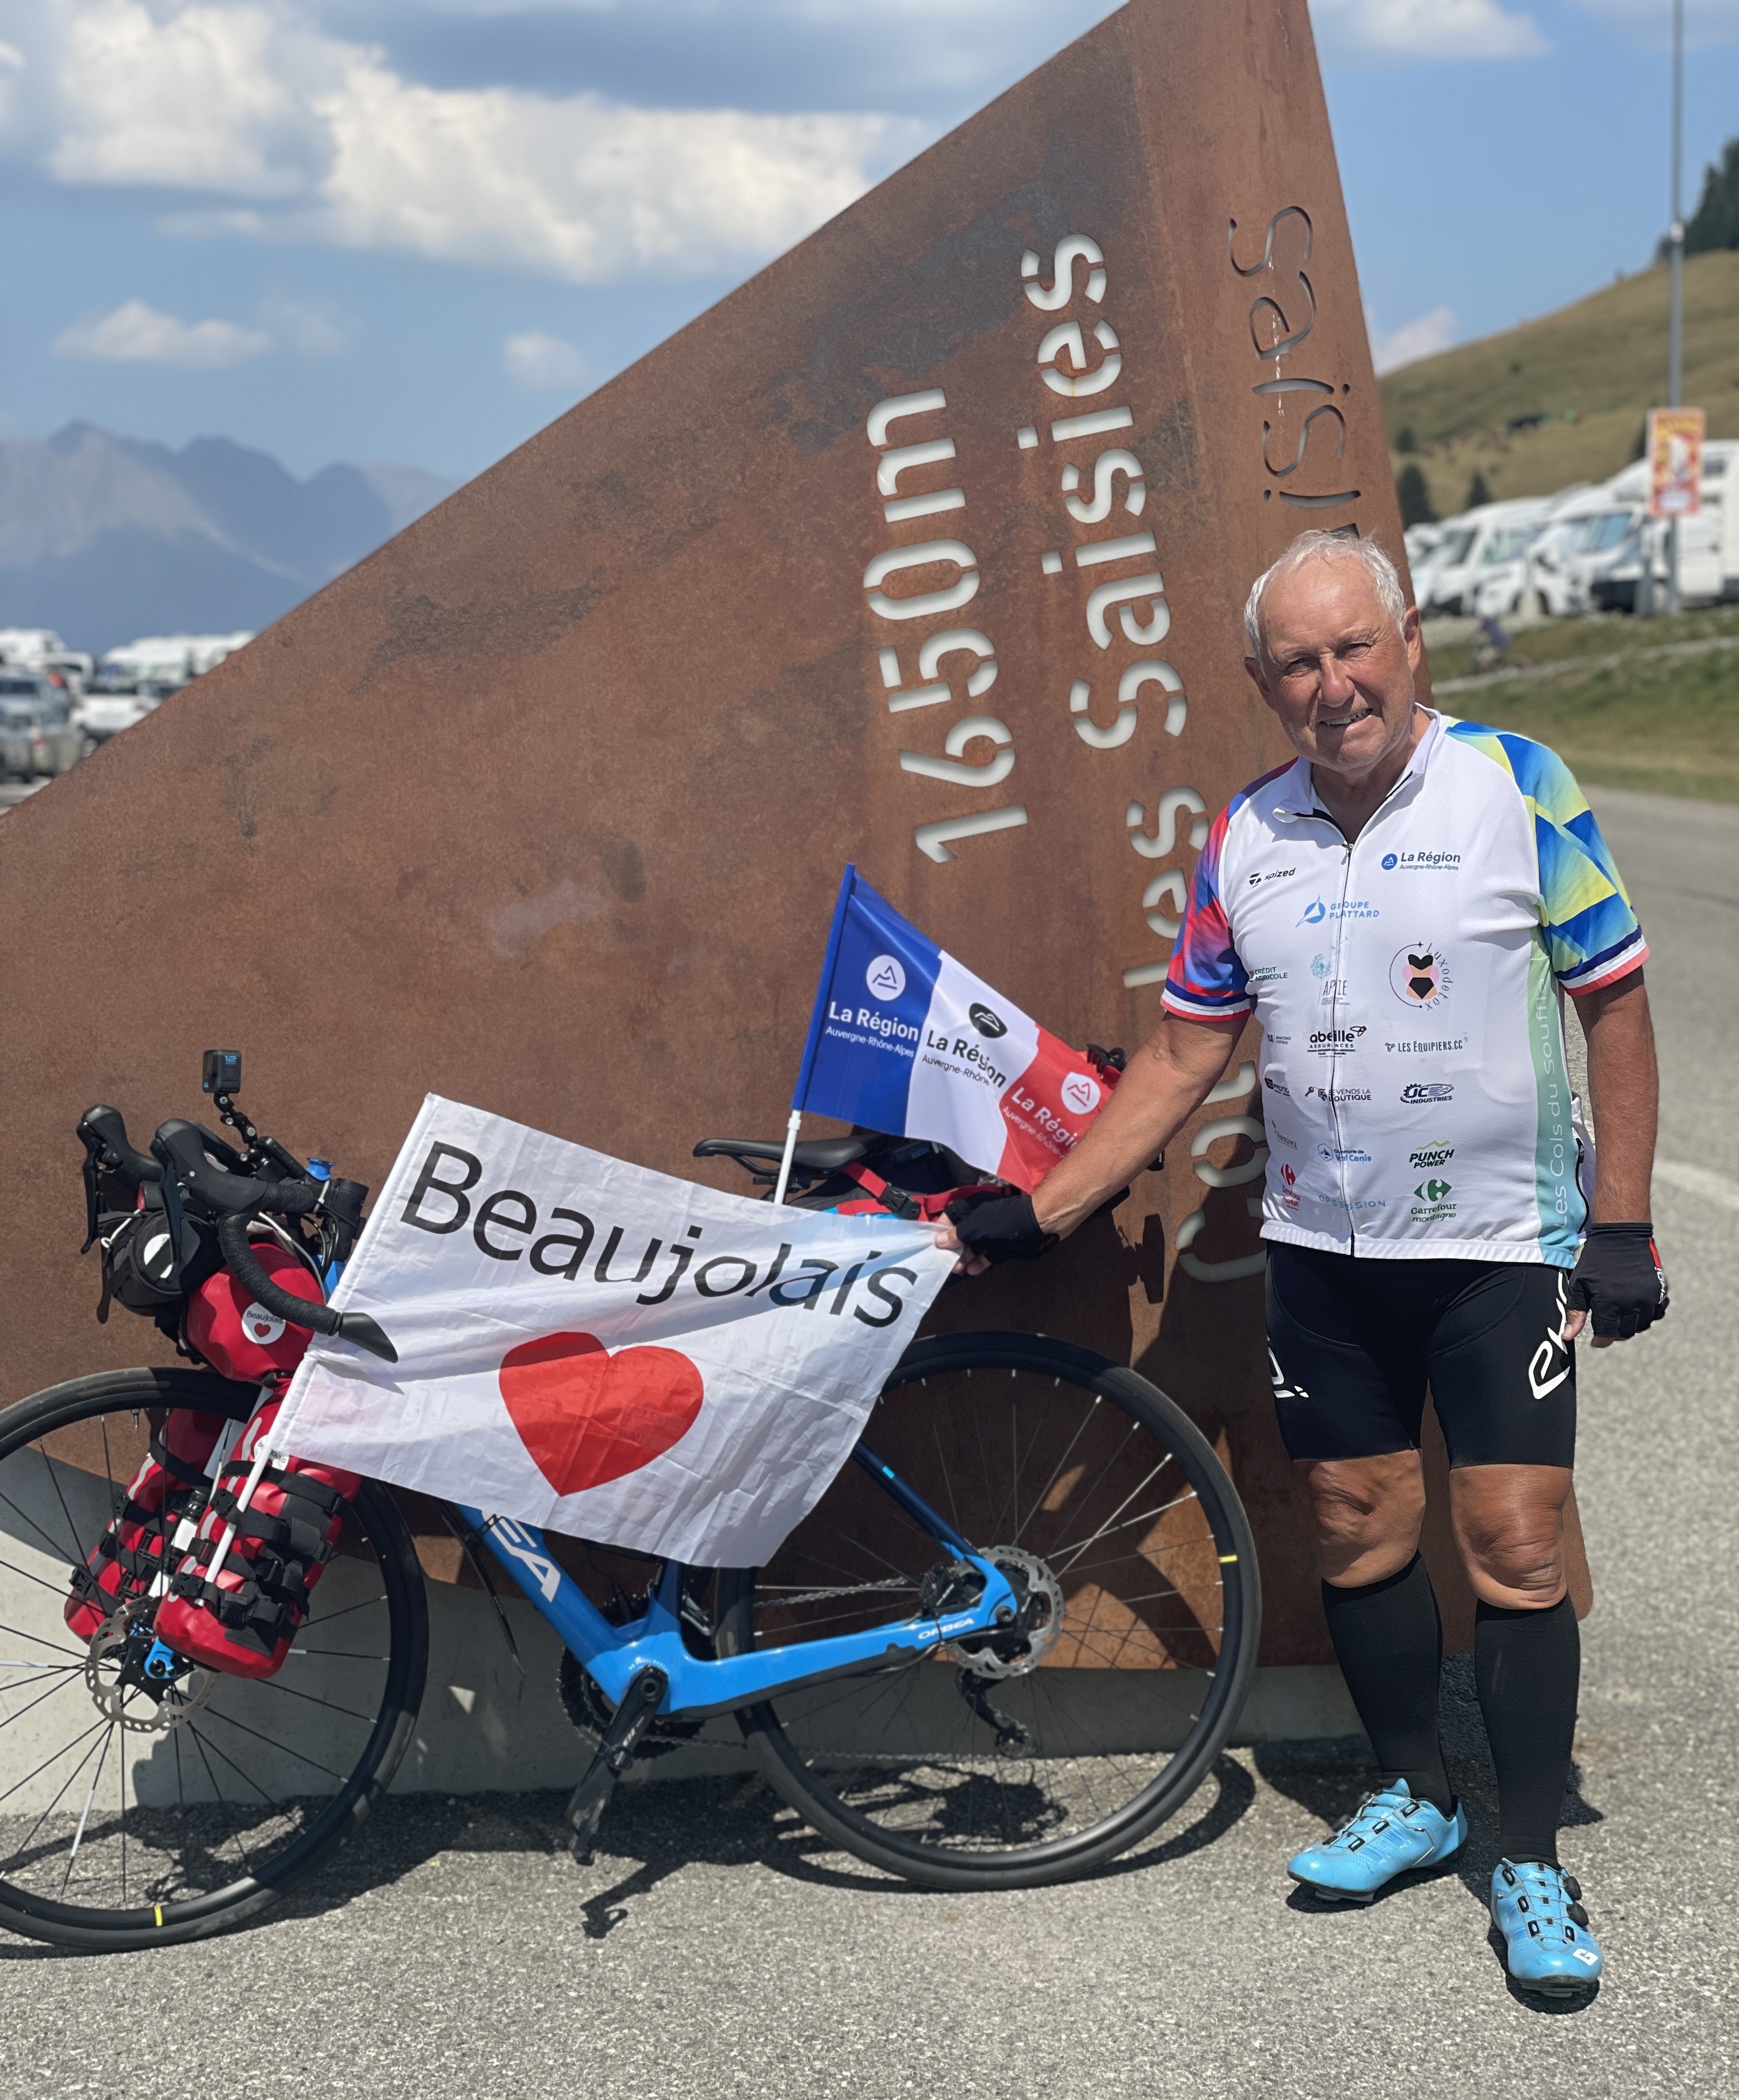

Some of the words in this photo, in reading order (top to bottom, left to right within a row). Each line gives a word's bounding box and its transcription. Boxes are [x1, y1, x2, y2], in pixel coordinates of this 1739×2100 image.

[1017, 233, 1188, 748] Saisies
[864, 388, 1028, 863] 1650m
[1401, 852, 1415, 862] La
[1418, 851, 1461, 864] Région
[1329, 910, 1380, 919] PLATTARD
[1254, 967, 1277, 975] CRÉDIT
[1254, 972, 1289, 982] AGRICOLE
[1426, 942, 1454, 1011] Luxodetox
[829, 1001, 853, 1022] La
[856, 1007, 919, 1042] Région
[826, 1026, 914, 1057] Auvergne-Rhône-Alpes
[926, 1029, 948, 1051] La
[1309, 1029, 1355, 1043] abeille
[1398, 1042, 1411, 1052] LES
[224, 1055, 237, 1063] 12
[922, 1055, 990, 1086] Auvergne-Rhône
[1410, 1095, 1453, 1105] INDUSTRIES
[1548, 1083, 1560, 1117] du
[1011, 1086, 1035, 1112] La
[1033, 1106, 1078, 1147] Régi
[1002, 1106, 1065, 1157] Auvergne-Rhône-
[1409, 1149, 1455, 1162] PUNCH
[1550, 1124, 1564, 1177] Cols
[1414, 1159, 1446, 1168] POWER
[1411, 1204, 1457, 1214] Carrefour
[1412, 1212, 1457, 1223] montagne
[1554, 1186, 1568, 1229] Les
[400, 1140, 919, 1328] Beaujolais
[246, 1310, 284, 1324] Beaujolais
[257, 1440, 286, 1463] Bejolais
[918, 1618, 975, 1640] ORBEA
